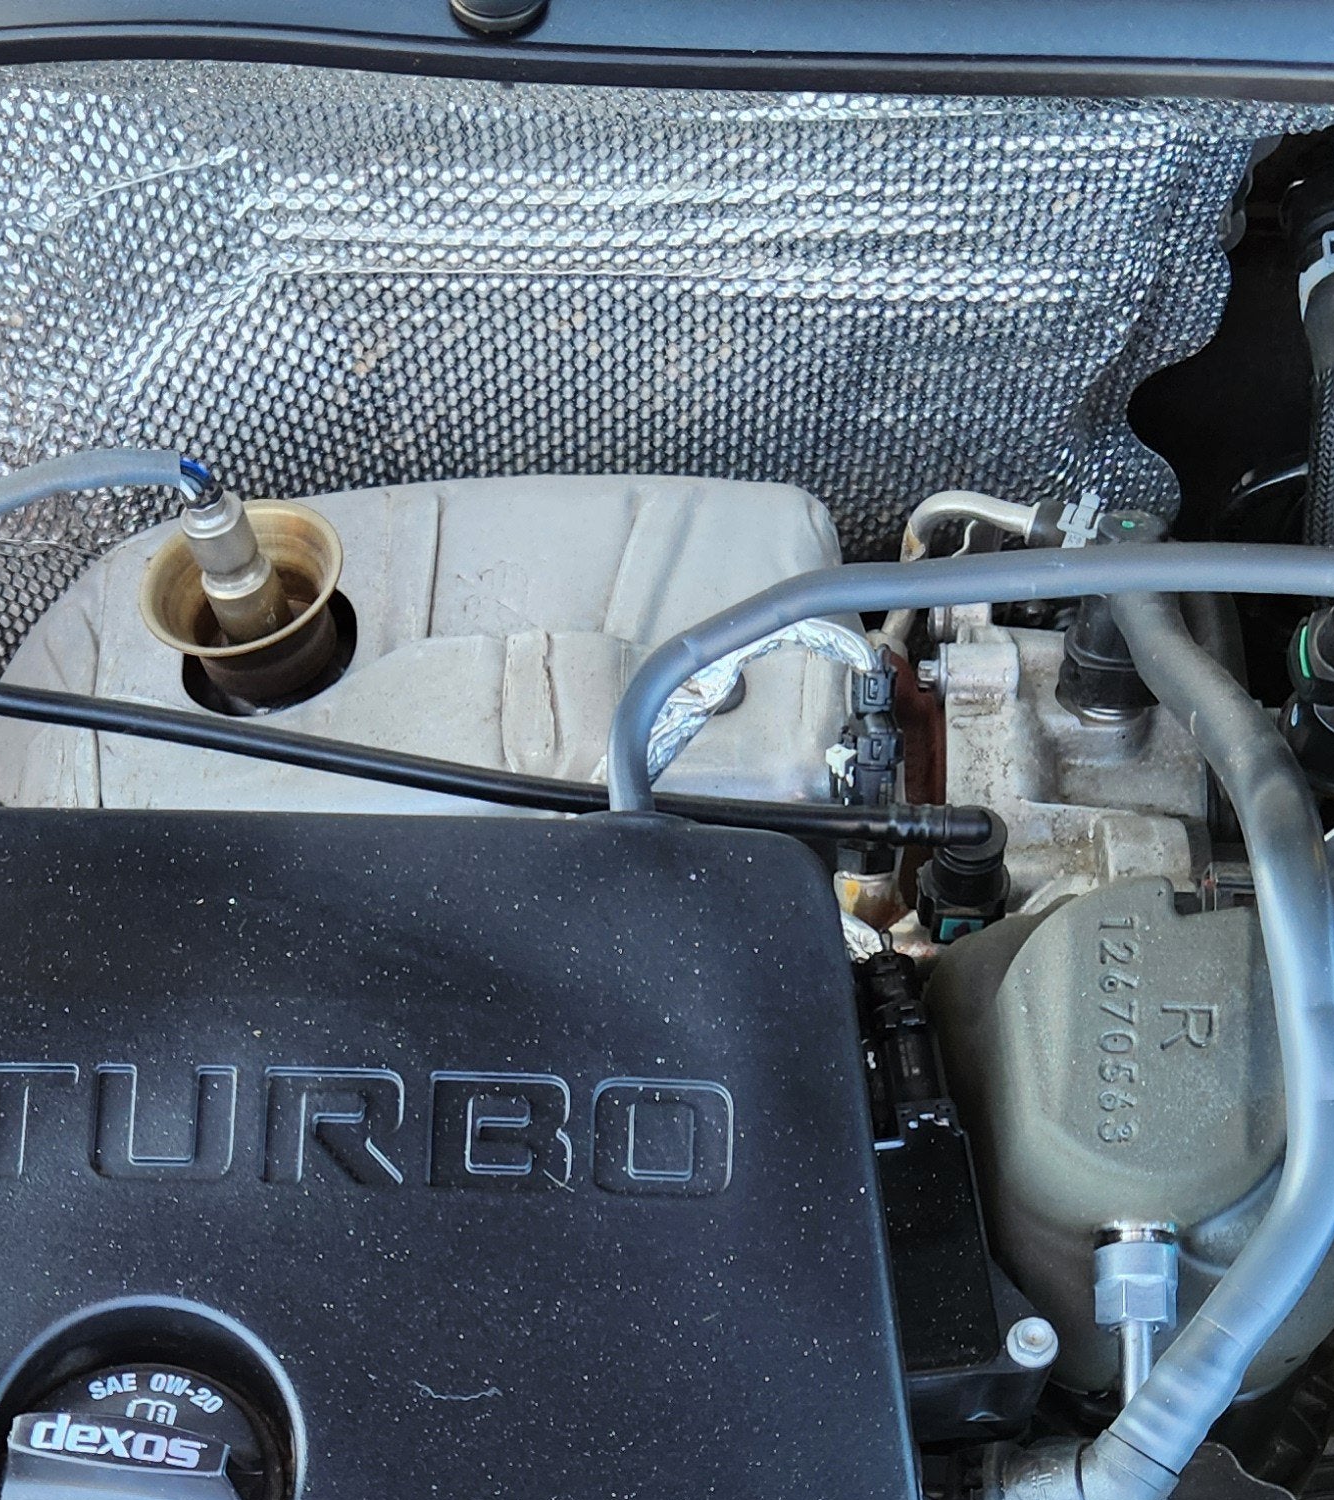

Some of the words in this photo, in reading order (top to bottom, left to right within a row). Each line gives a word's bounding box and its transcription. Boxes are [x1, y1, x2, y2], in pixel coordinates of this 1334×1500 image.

[1097, 915, 1140, 1145] 12670563
[1159, 1001, 1220, 1052] R
[88, 1373, 138, 1400] SAE
[149, 1373, 223, 1414] 0W-20
[30, 1413, 200, 1469] dexos
